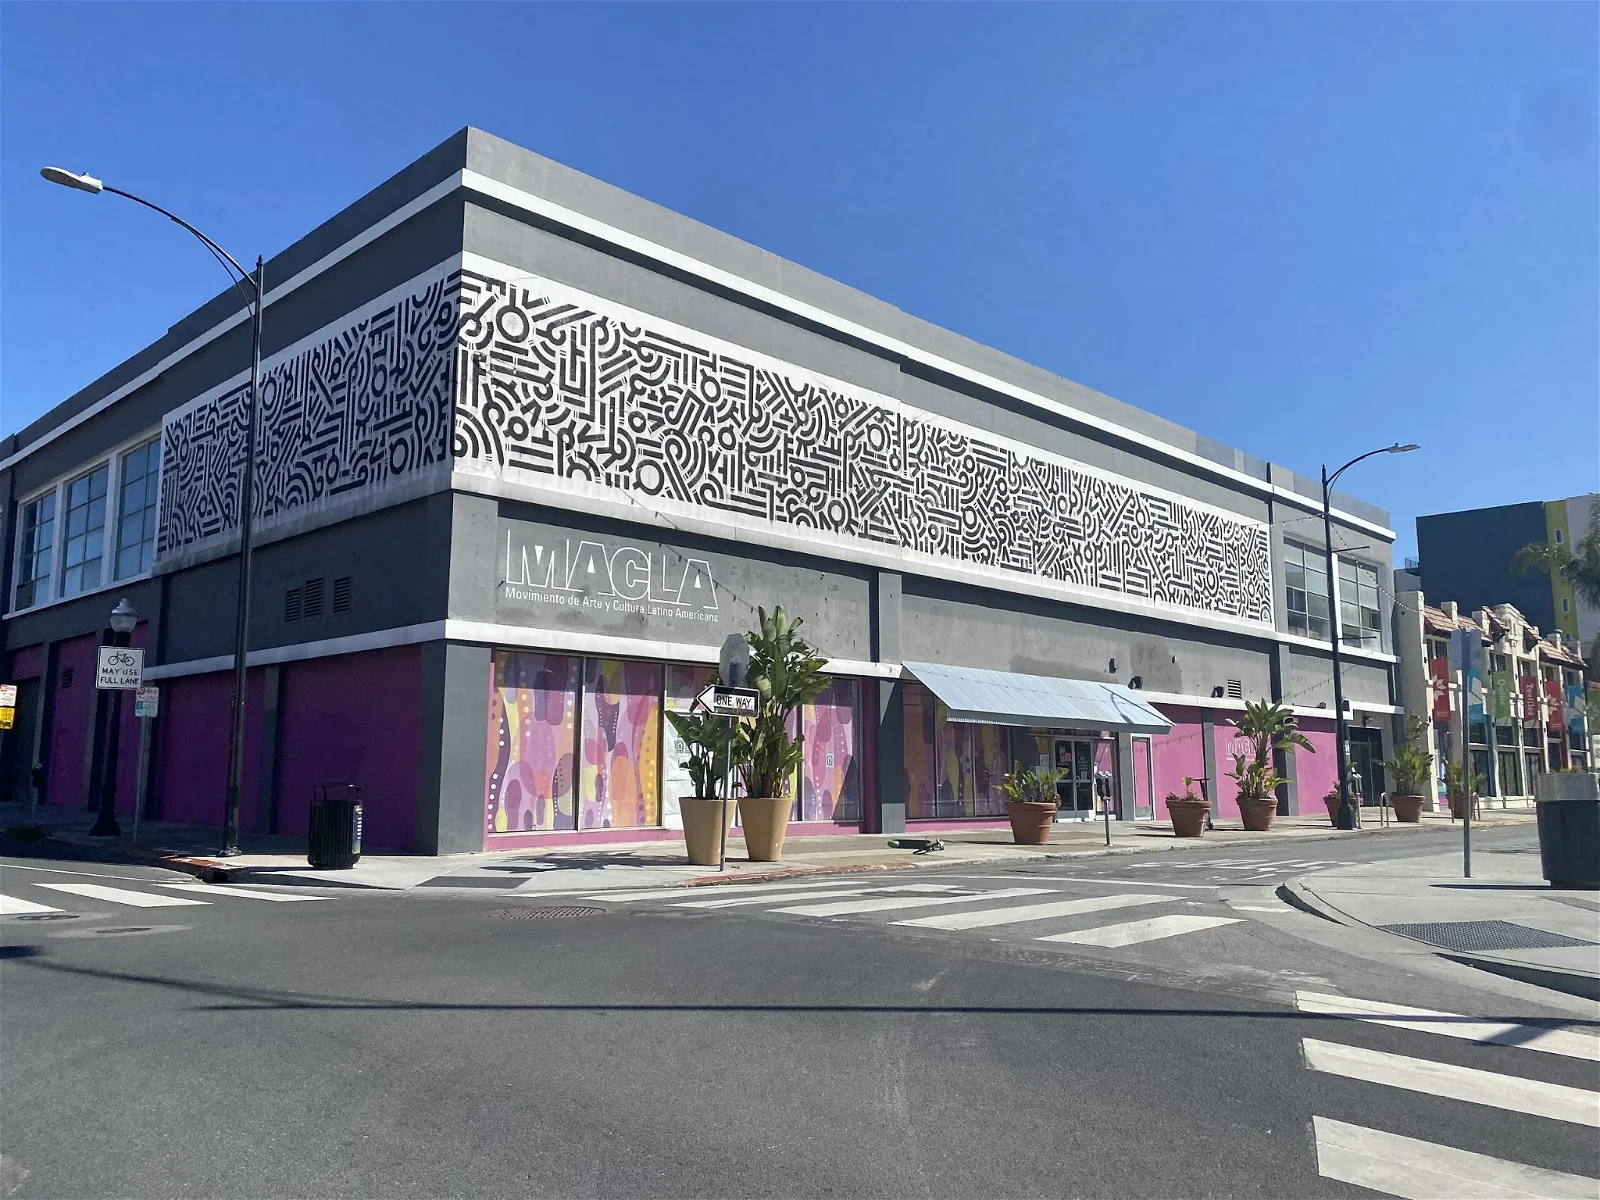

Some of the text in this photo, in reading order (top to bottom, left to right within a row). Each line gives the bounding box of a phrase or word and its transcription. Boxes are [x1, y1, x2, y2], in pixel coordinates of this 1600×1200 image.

[506, 529, 719, 609] MACLA
[505, 587, 719, 623] Movimiento de Arte y Cultura Latino Americana
[102, 667, 138, 676] MAY USE
[100, 676, 139, 685] FULL LANE
[716, 695, 752, 707] ONE WAY
